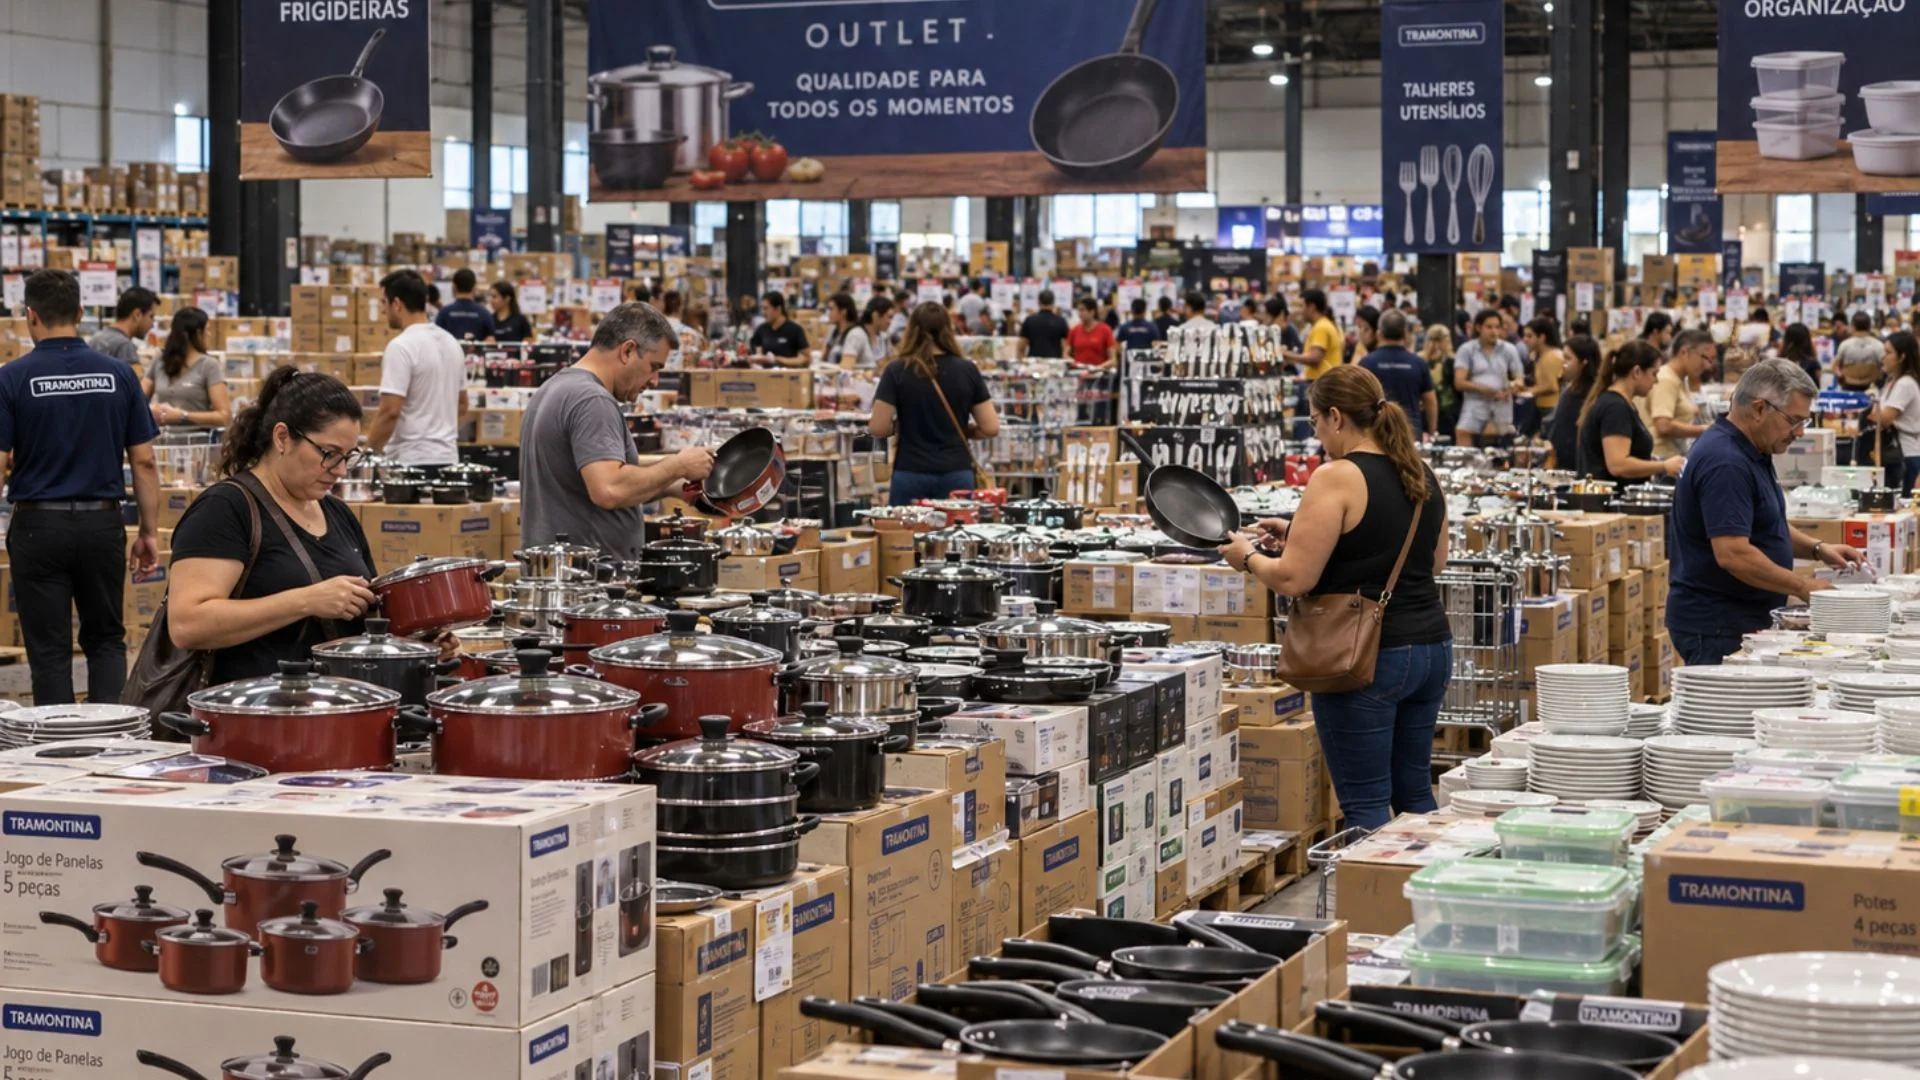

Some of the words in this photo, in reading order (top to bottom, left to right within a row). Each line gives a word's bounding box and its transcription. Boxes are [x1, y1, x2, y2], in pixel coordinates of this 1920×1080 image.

[280, 0, 409, 22] FRIGIDEIRAS
[805, 18, 966, 49] OUTLET
[1404, 28, 1478, 41] TRAMONTINA
[796, 70, 919, 94] QUALIDADE
[930, 68, 986, 88] PARA
[1402, 81, 1476, 97] TALHERES
[767, 100, 839, 119] TODOS
[848, 98, 878, 117] OS
[888, 95, 1015, 116] MOMENTOS
[1400, 100, 1486, 120] UTENSÍLIOS
[37, 377, 111, 393] TRAMONTINA
[9, 816, 95, 835] TRAMONTINA
[3, 850, 33, 868] Jogo
[36, 852, 52, 866] de
[55, 853, 103, 870] Panelas
[3, 870, 13, 893] 5
[18, 881, 61, 899] peças
[1679, 882, 1794, 904] TRAMONTINA
[1853, 893, 1898, 911] Potes
[1853, 917, 1864, 932] 4
[1869, 920, 1917, 937] peças
[9, 1010, 95, 1031] TRAMONTINA
[1581, 1006, 1676, 1027] TRAMONTINA
[3, 1045, 33, 1063] Jogo
[36, 1048, 52, 1063] de
[55, 1049, 103, 1067] Panelas
